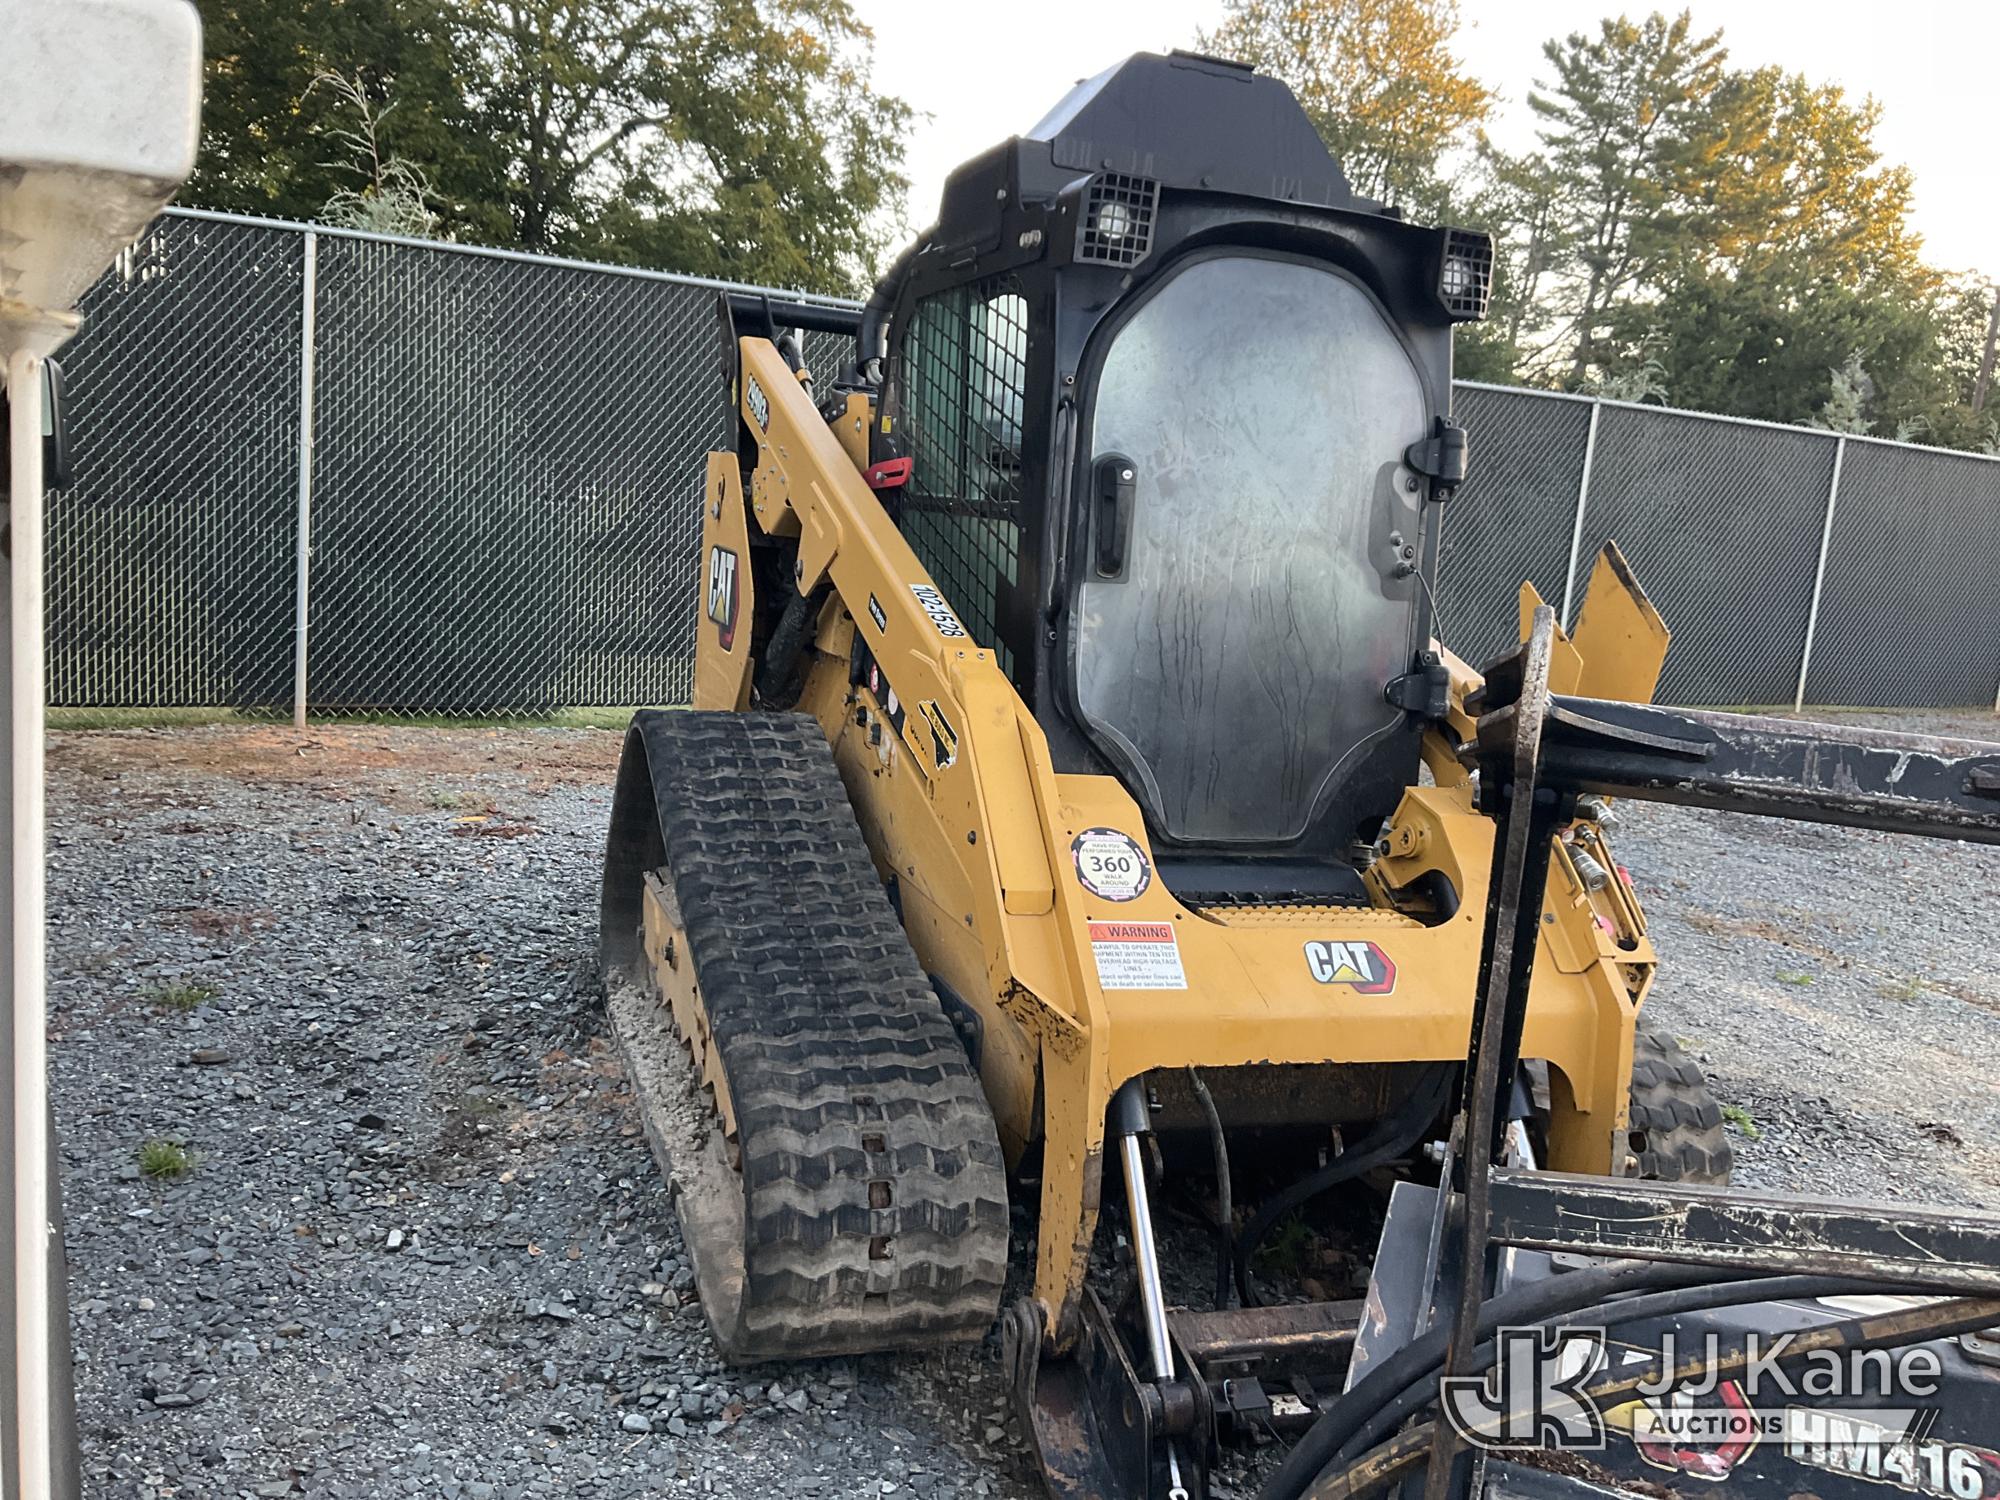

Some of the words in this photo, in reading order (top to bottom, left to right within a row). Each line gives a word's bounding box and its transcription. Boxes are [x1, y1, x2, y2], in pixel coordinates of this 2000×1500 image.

[708, 547, 736, 626] CAT
[912, 587, 965, 637] 102-1528
[1100, 879, 1130, 887] AROUND
[1107, 926, 1168, 938] WARNING
[1305, 942, 1374, 983] CAT
[1789, 1408, 1983, 1500] HM416
